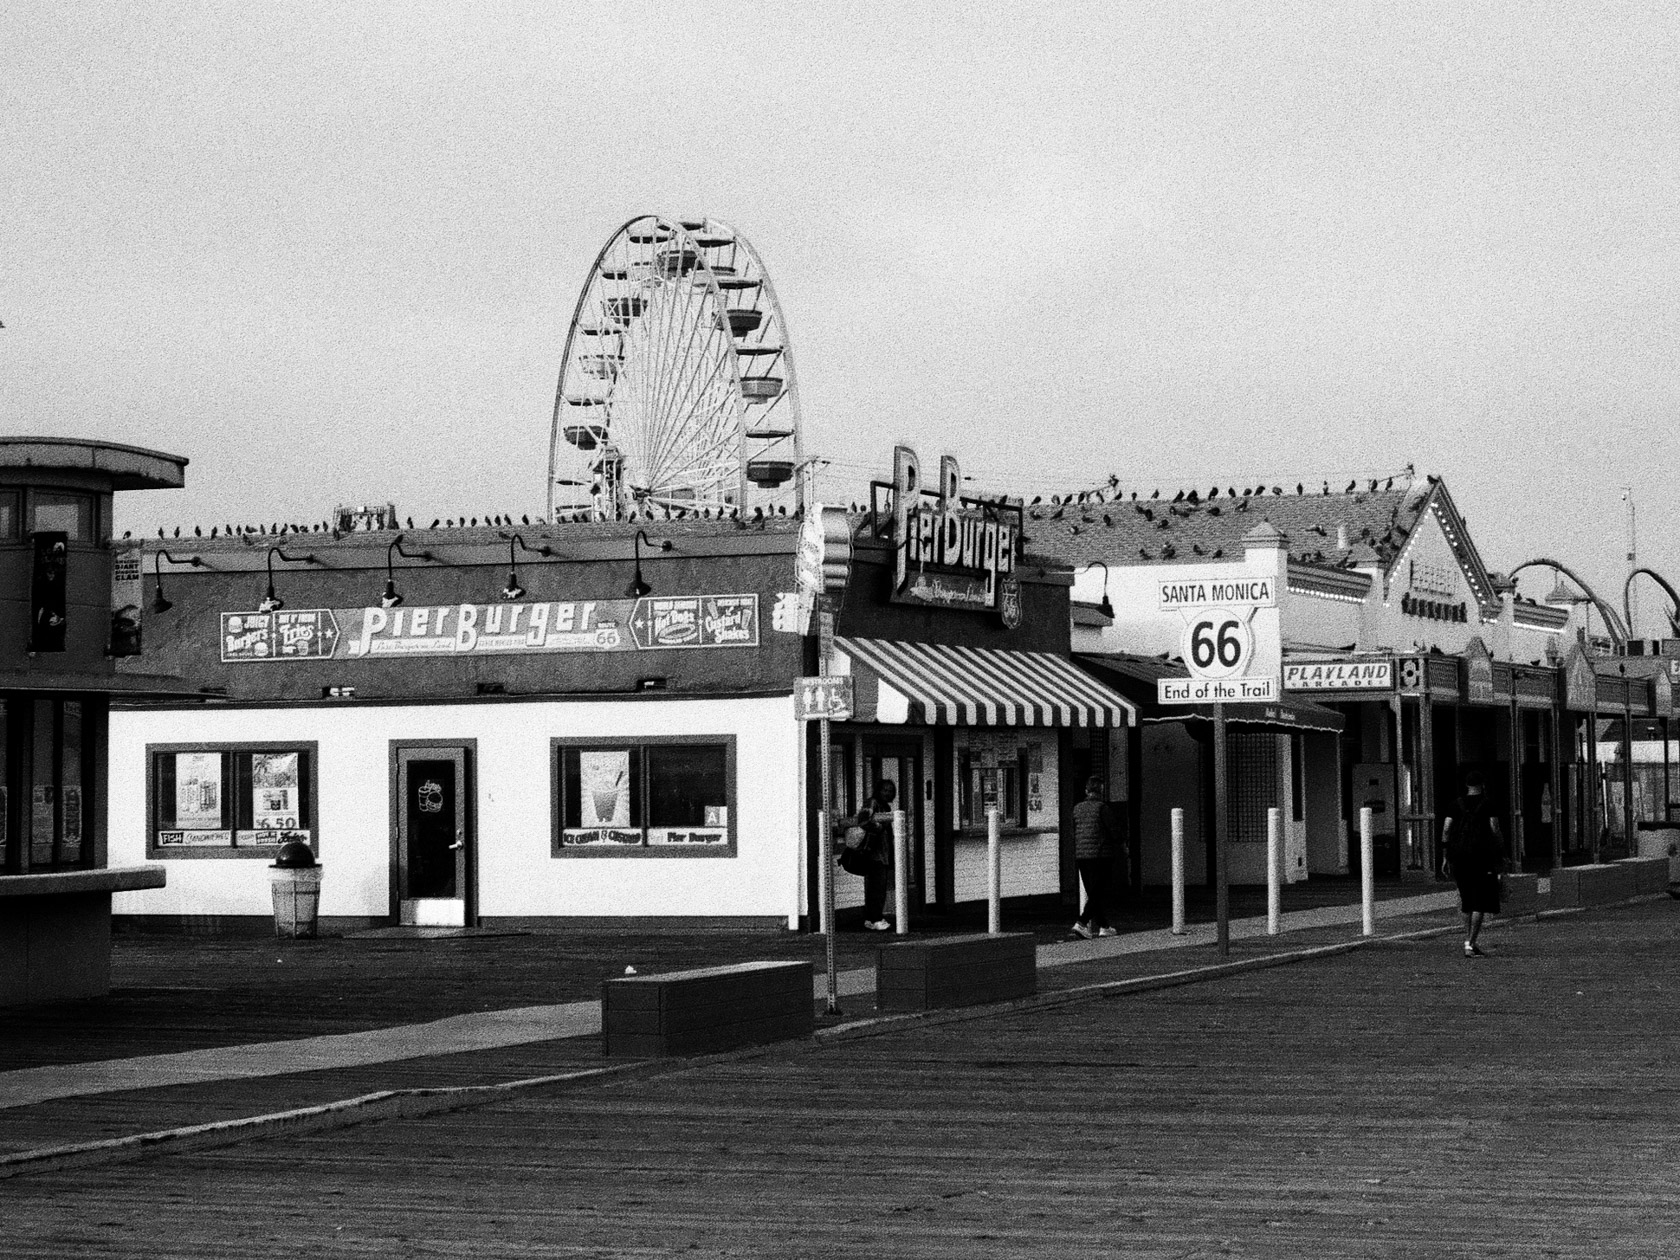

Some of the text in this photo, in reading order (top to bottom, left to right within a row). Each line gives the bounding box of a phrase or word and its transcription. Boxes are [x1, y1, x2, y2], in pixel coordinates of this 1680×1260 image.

[1162, 582, 1269, 603] SANTA MONICA
[244, 615, 270, 629] JUICY
[706, 610, 742, 633] Custard
[226, 628, 269, 653] Burgers
[279, 624, 314, 646] Fries
[597, 632, 617, 645] 66
[715, 628, 750, 643] Shakes
[1191, 620, 1242, 668] 66
[1287, 664, 1388, 681] PLAYLAND
[802, 677, 844, 685] RESTROOMS
[1302, 680, 1373, 688] ARCADE
[1164, 682, 1270, 699] End of the Trail
[707, 811, 718, 823] A
[162, 833, 183, 843] FISH
